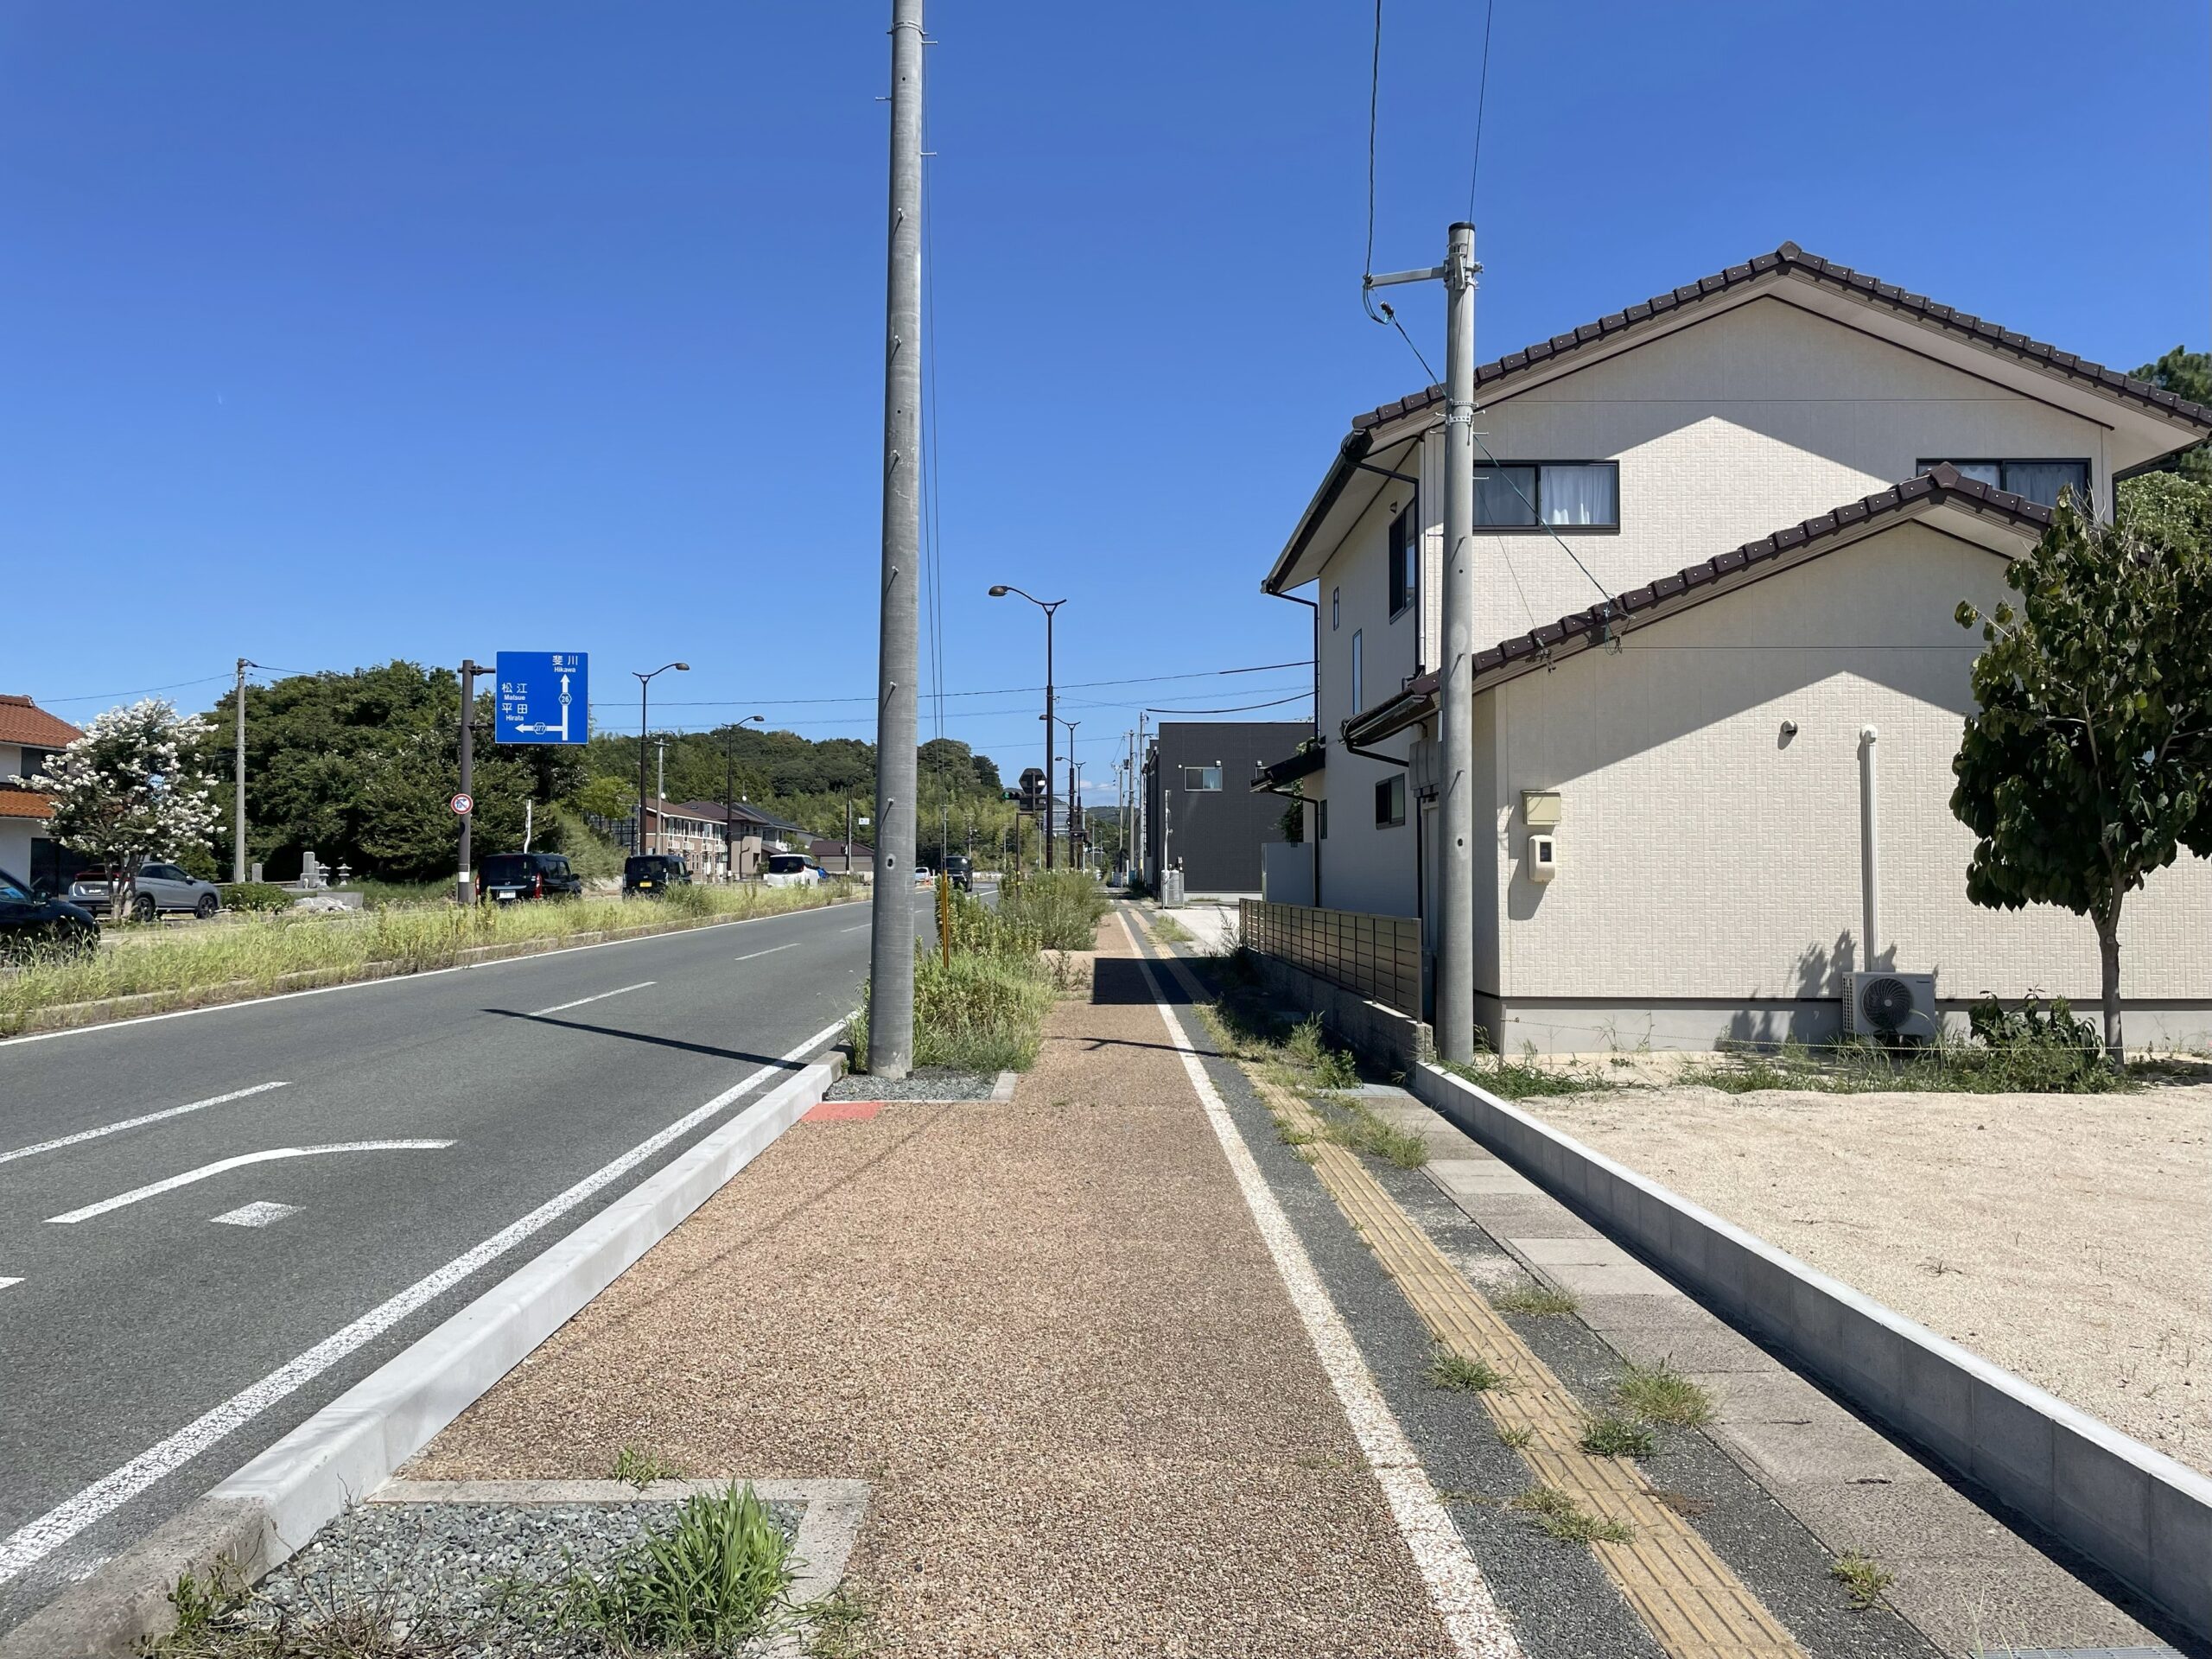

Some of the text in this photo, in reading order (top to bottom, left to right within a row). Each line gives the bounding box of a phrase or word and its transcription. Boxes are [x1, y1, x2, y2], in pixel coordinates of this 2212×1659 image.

[552, 655, 578, 665] 斐川
[501, 683, 528, 694] 松江
[501, 702, 528, 715] 平田
